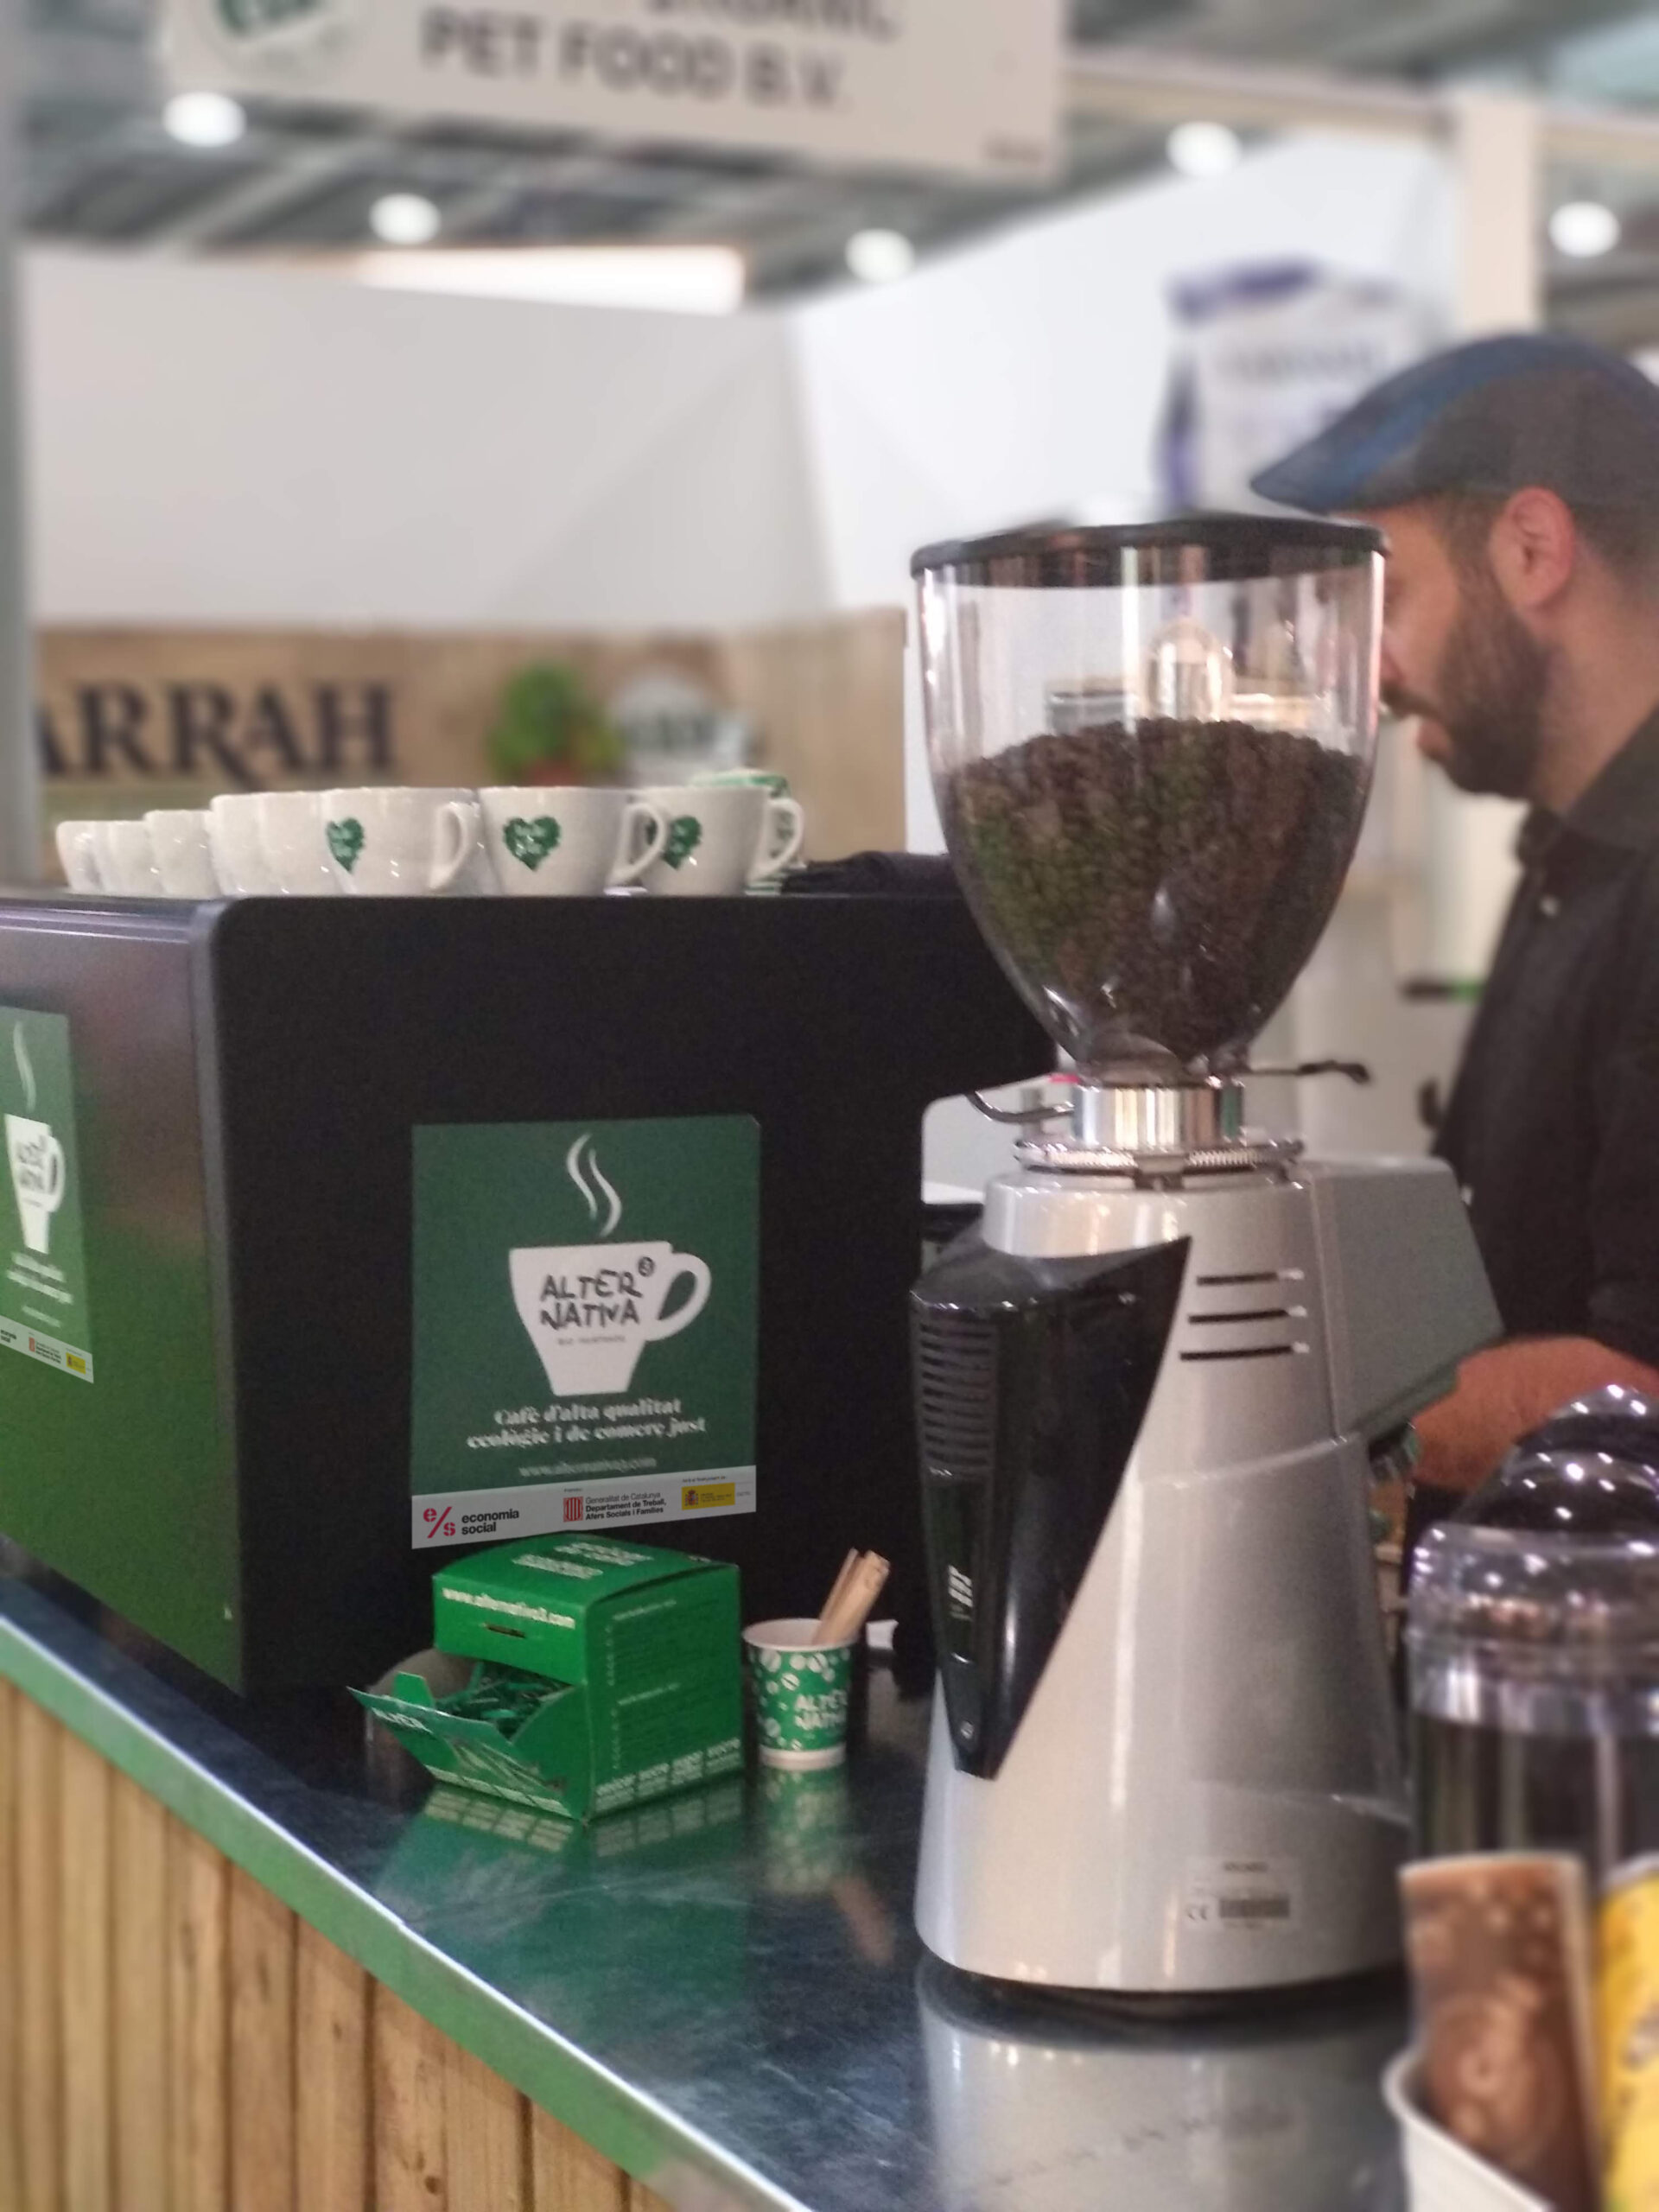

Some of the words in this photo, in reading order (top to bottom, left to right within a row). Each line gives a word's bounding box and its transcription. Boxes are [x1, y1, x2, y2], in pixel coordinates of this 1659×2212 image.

[421, 6, 543, 78] PET
[559, 21, 736, 102] FOOD
[540, 1268, 643, 1301] ALTER
[586, 1495, 620, 1505] Generalitat
[631, 1491, 661, 1502] Catalunya
[586, 1502, 631, 1513] Departament
[461, 1509, 519, 1524] economia
[586, 1511, 605, 1521] Afers
[607, 1510, 631, 1519] Socials
[461, 1522, 497, 1535] social
